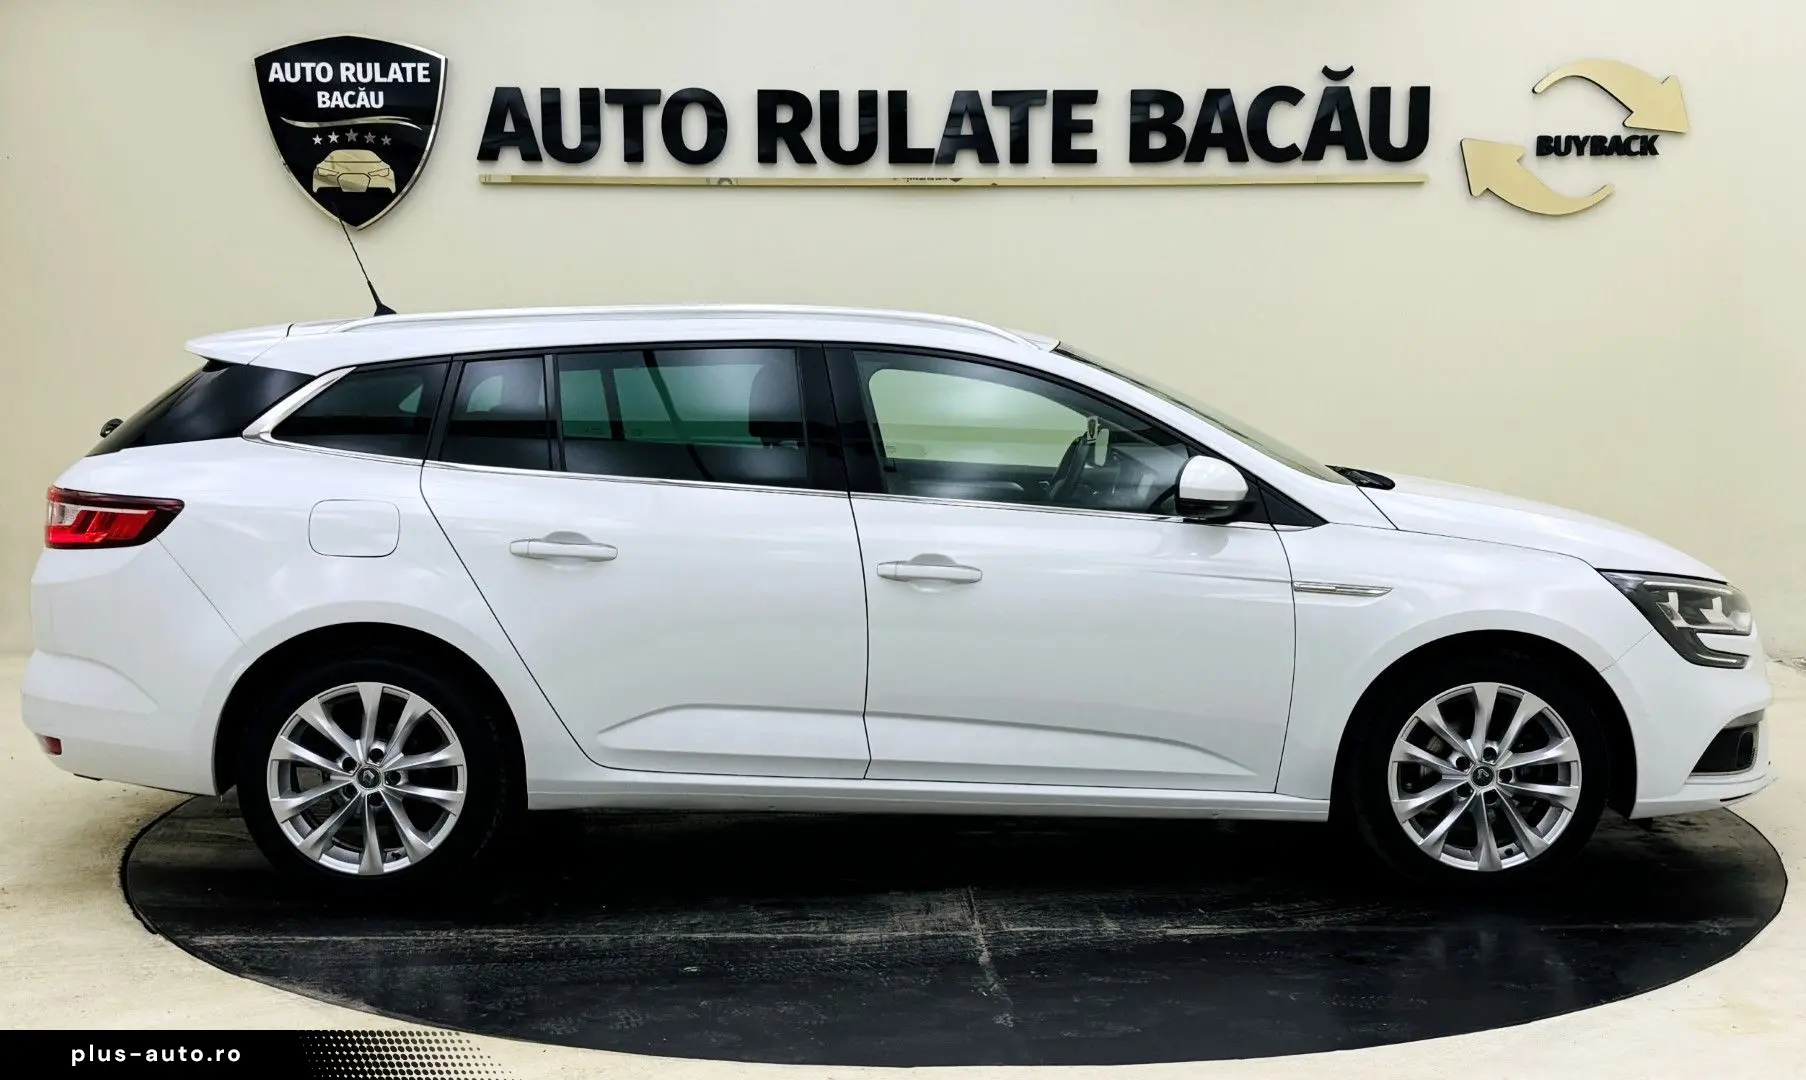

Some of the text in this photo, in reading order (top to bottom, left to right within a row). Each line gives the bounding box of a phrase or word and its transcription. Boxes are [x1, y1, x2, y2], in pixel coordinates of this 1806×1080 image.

[268, 62, 431, 83] AUTO RULATE
[316, 87, 384, 109] BACĂU
[476, 65, 1431, 165] AUTO RULATE BACĂU
[1535, 134, 1660, 157] BUYBACK
